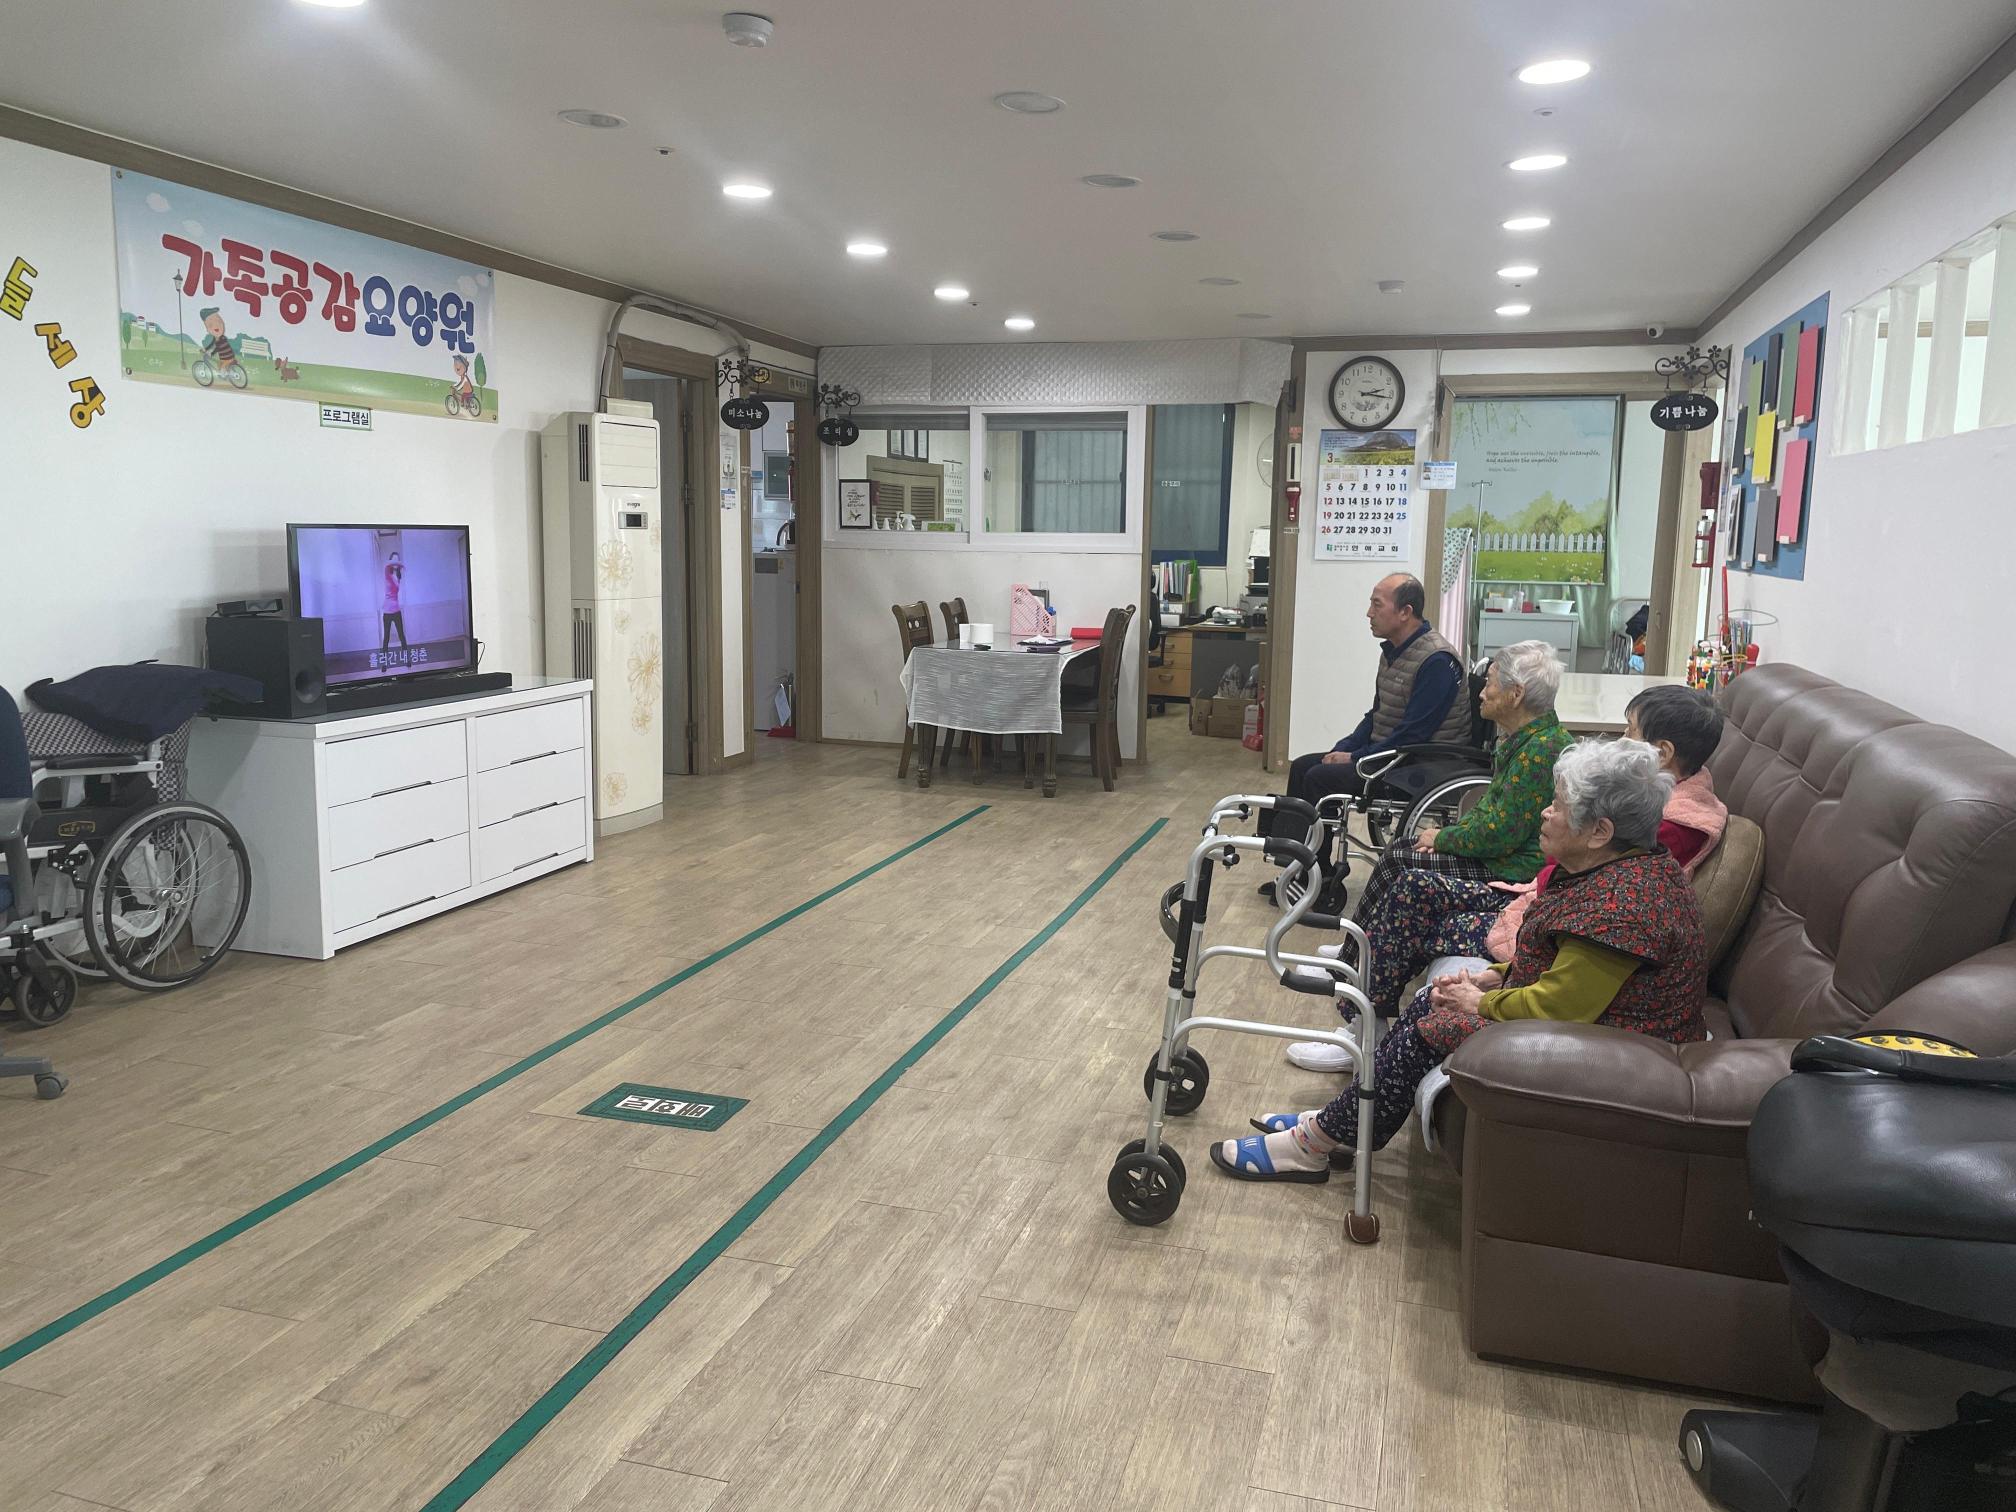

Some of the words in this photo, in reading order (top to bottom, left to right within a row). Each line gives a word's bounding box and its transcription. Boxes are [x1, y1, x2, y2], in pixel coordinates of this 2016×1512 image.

[1659, 405, 1708, 419] 기쁨나눔
[322, 408, 369, 426] 프로그램실
[1327, 452, 1333, 463] 3
[1376, 469, 1382, 477] 2
[1389, 469, 1394, 477] 3
[1401, 469, 1407, 477] 4
[1326, 483, 1331, 491] 5
[1338, 483, 1343, 491] 6
[1350, 483, 1356, 491] 7
[1363, 483, 1368, 491] 8
[1375, 483, 1380, 491] 9
[1387, 483, 1396, 491] 10
[1399, 483, 1407, 491] 11
[1324, 497, 1333, 506] 12
[1336, 497, 1345, 506] 13
[1348, 497, 1357, 506] 14
[1361, 497, 1370, 506] 15
[1373, 497, 1382, 506] 16
[1386, 497, 1395, 506] 17
[1398, 497, 1407, 506] 18
[1323, 512, 1332, 520] 19
[1334, 512, 1345, 520] 20
[1347, 512, 1356, 520] 21
[1359, 512, 1369, 520] 22
[1371, 512, 1381, 520] 23
[1384, 512, 1394, 520] 24
[1396, 512, 1407, 520] 25
[1321, 526, 1331, 534] 26
[1333, 526, 1344, 534] 27
[1346, 526, 1356, 534] 28
[1358, 526, 1368, 534] 29
[1370, 526, 1381, 534] 30
[1383, 526, 1392, 534] 31
[399, 649, 408, 664] 내
[410, 647, 428, 663] 청춘
